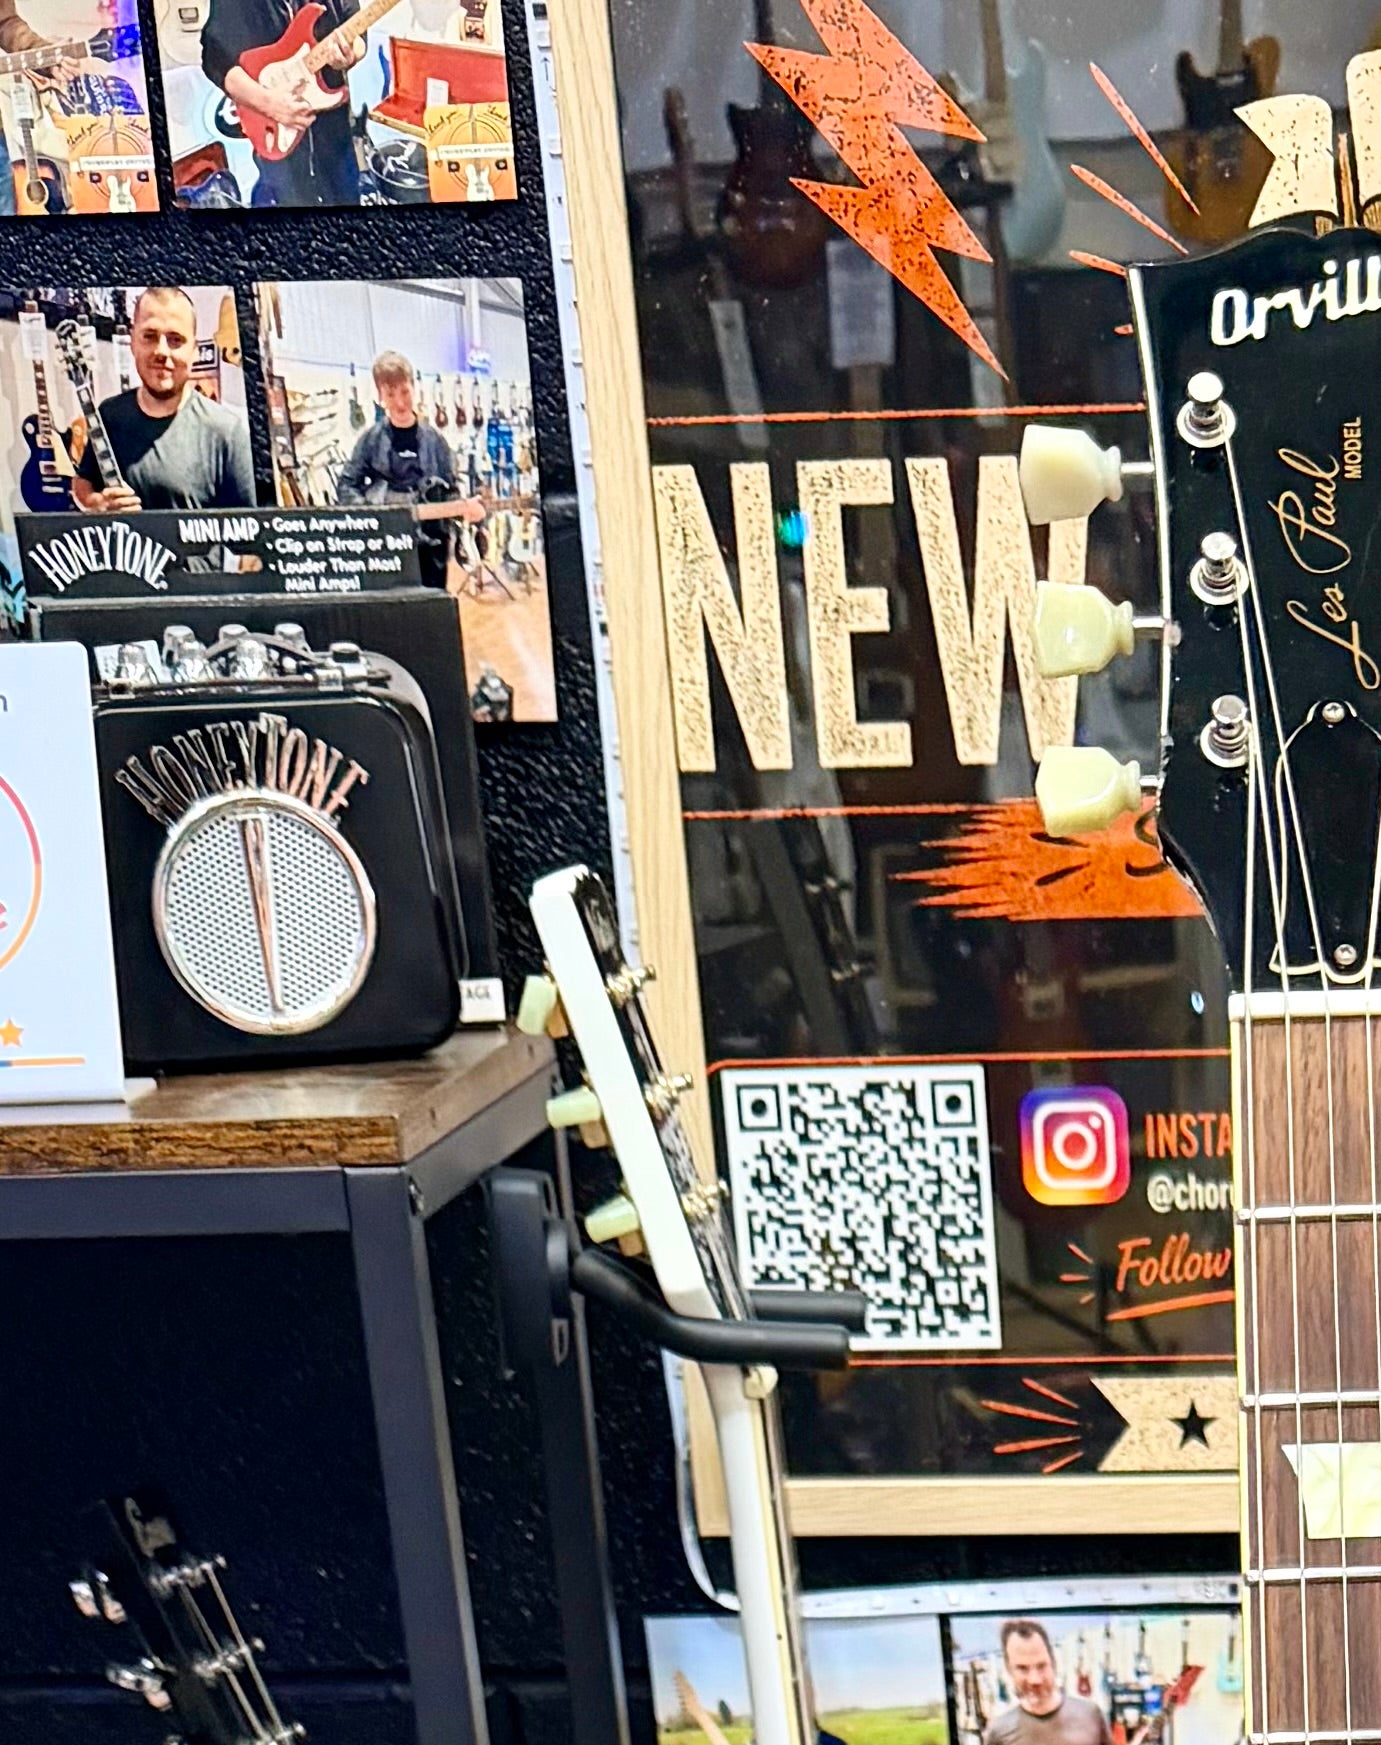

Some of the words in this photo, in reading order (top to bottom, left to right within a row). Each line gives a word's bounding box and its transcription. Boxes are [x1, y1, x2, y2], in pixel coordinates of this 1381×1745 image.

[1343, 415, 1363, 480] MODEL
[178, 517, 222, 543] MINI
[223, 516, 260, 542] AMP
[272, 516, 307, 533] Goes
[309, 514, 380, 534] Anywhere
[1267, 447, 1352, 574] Paul
[28, 520, 177, 593] HONEYTONE
[274, 540, 302, 556] Clip
[306, 540, 326, 553] on
[327, 536, 365, 555] Strap
[367, 538, 384, 552] or
[385, 533, 414, 551] Belt
[278, 558, 327, 576] Louder
[329, 556, 366, 573] Than
[367, 555, 402, 572] Most
[284, 576, 317, 592] Mini
[652, 455, 1090, 772] NEW
[1286, 583, 1381, 690] Les
[113, 712, 370, 832] HONEYTONE
[1144, 1112, 1234, 1159] INSTA
[1115, 1231, 1232, 1293] Follow
